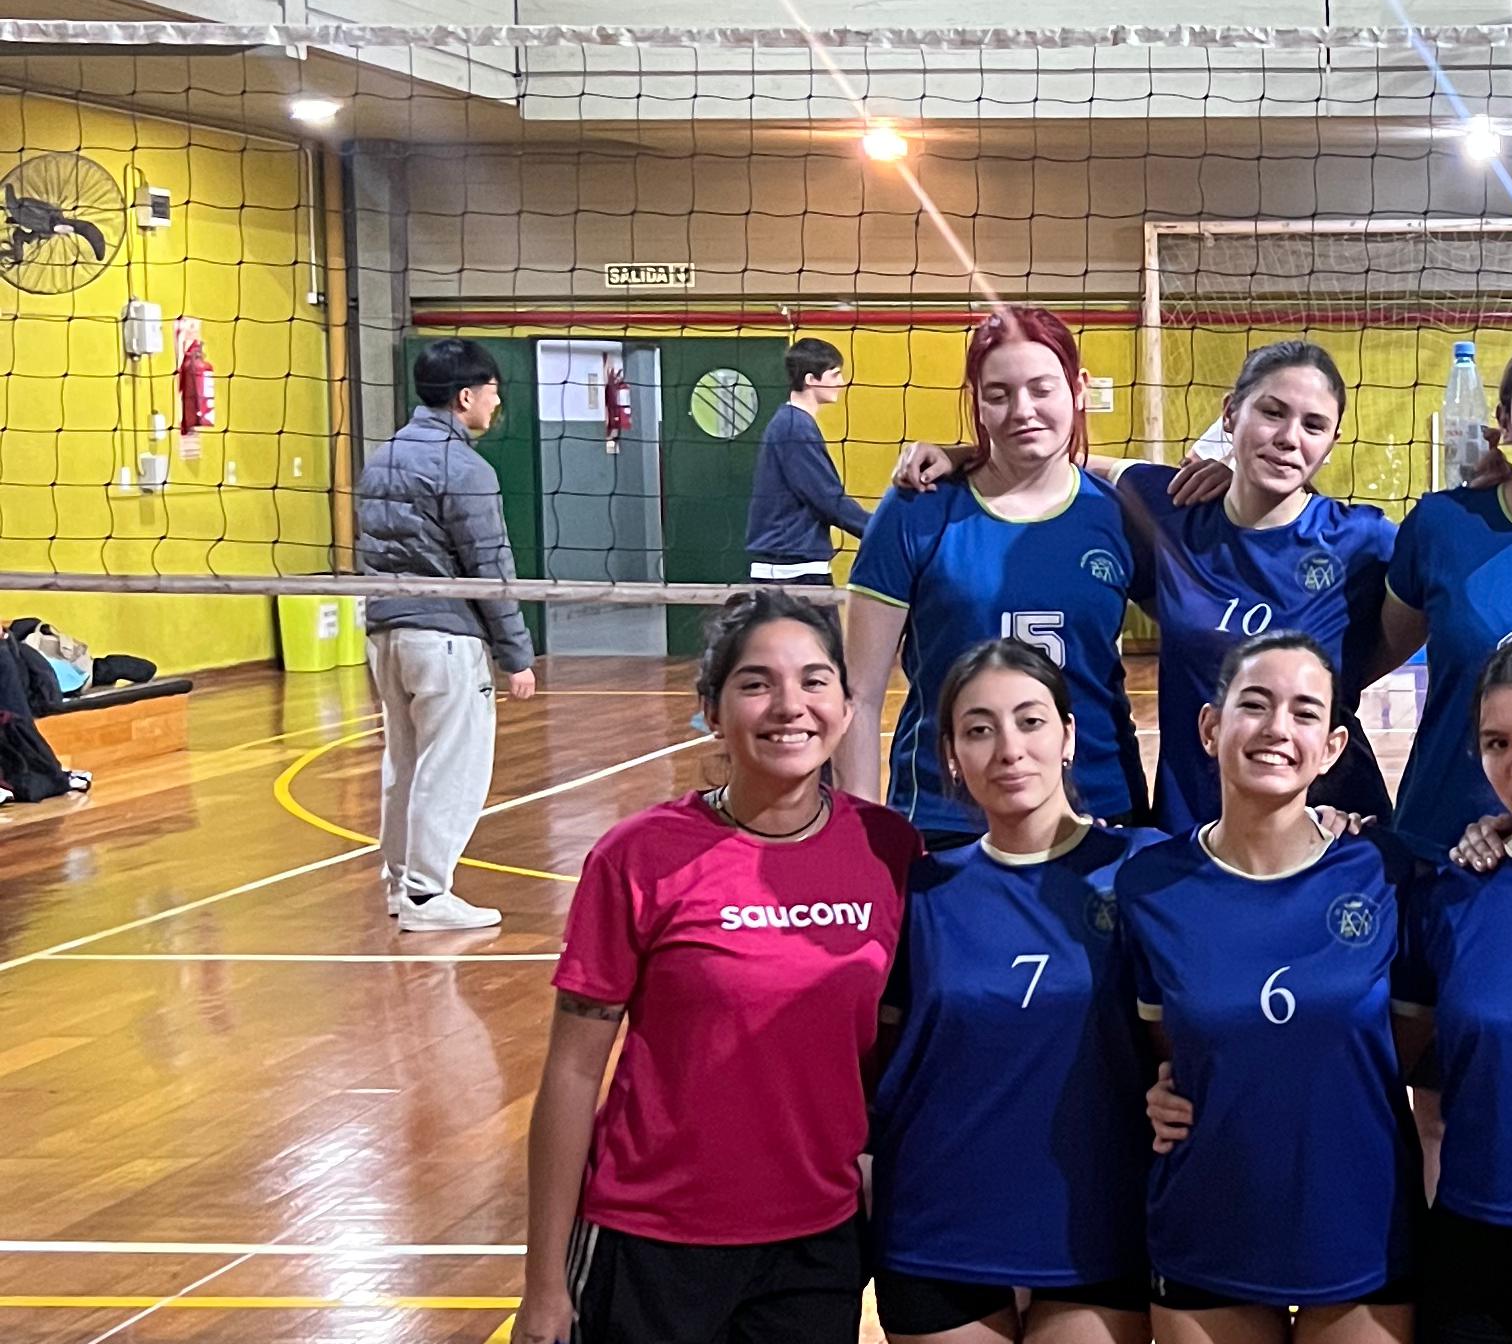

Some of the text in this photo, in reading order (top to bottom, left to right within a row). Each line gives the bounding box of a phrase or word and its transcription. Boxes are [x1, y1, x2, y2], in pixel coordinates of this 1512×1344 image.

[609, 267, 668, 284] SALIDA
[1215, 597, 1272, 636] 10
[720, 902, 873, 931] saucony
[1011, 954, 1050, 1008] 7
[1260, 965, 1296, 1024] 6
